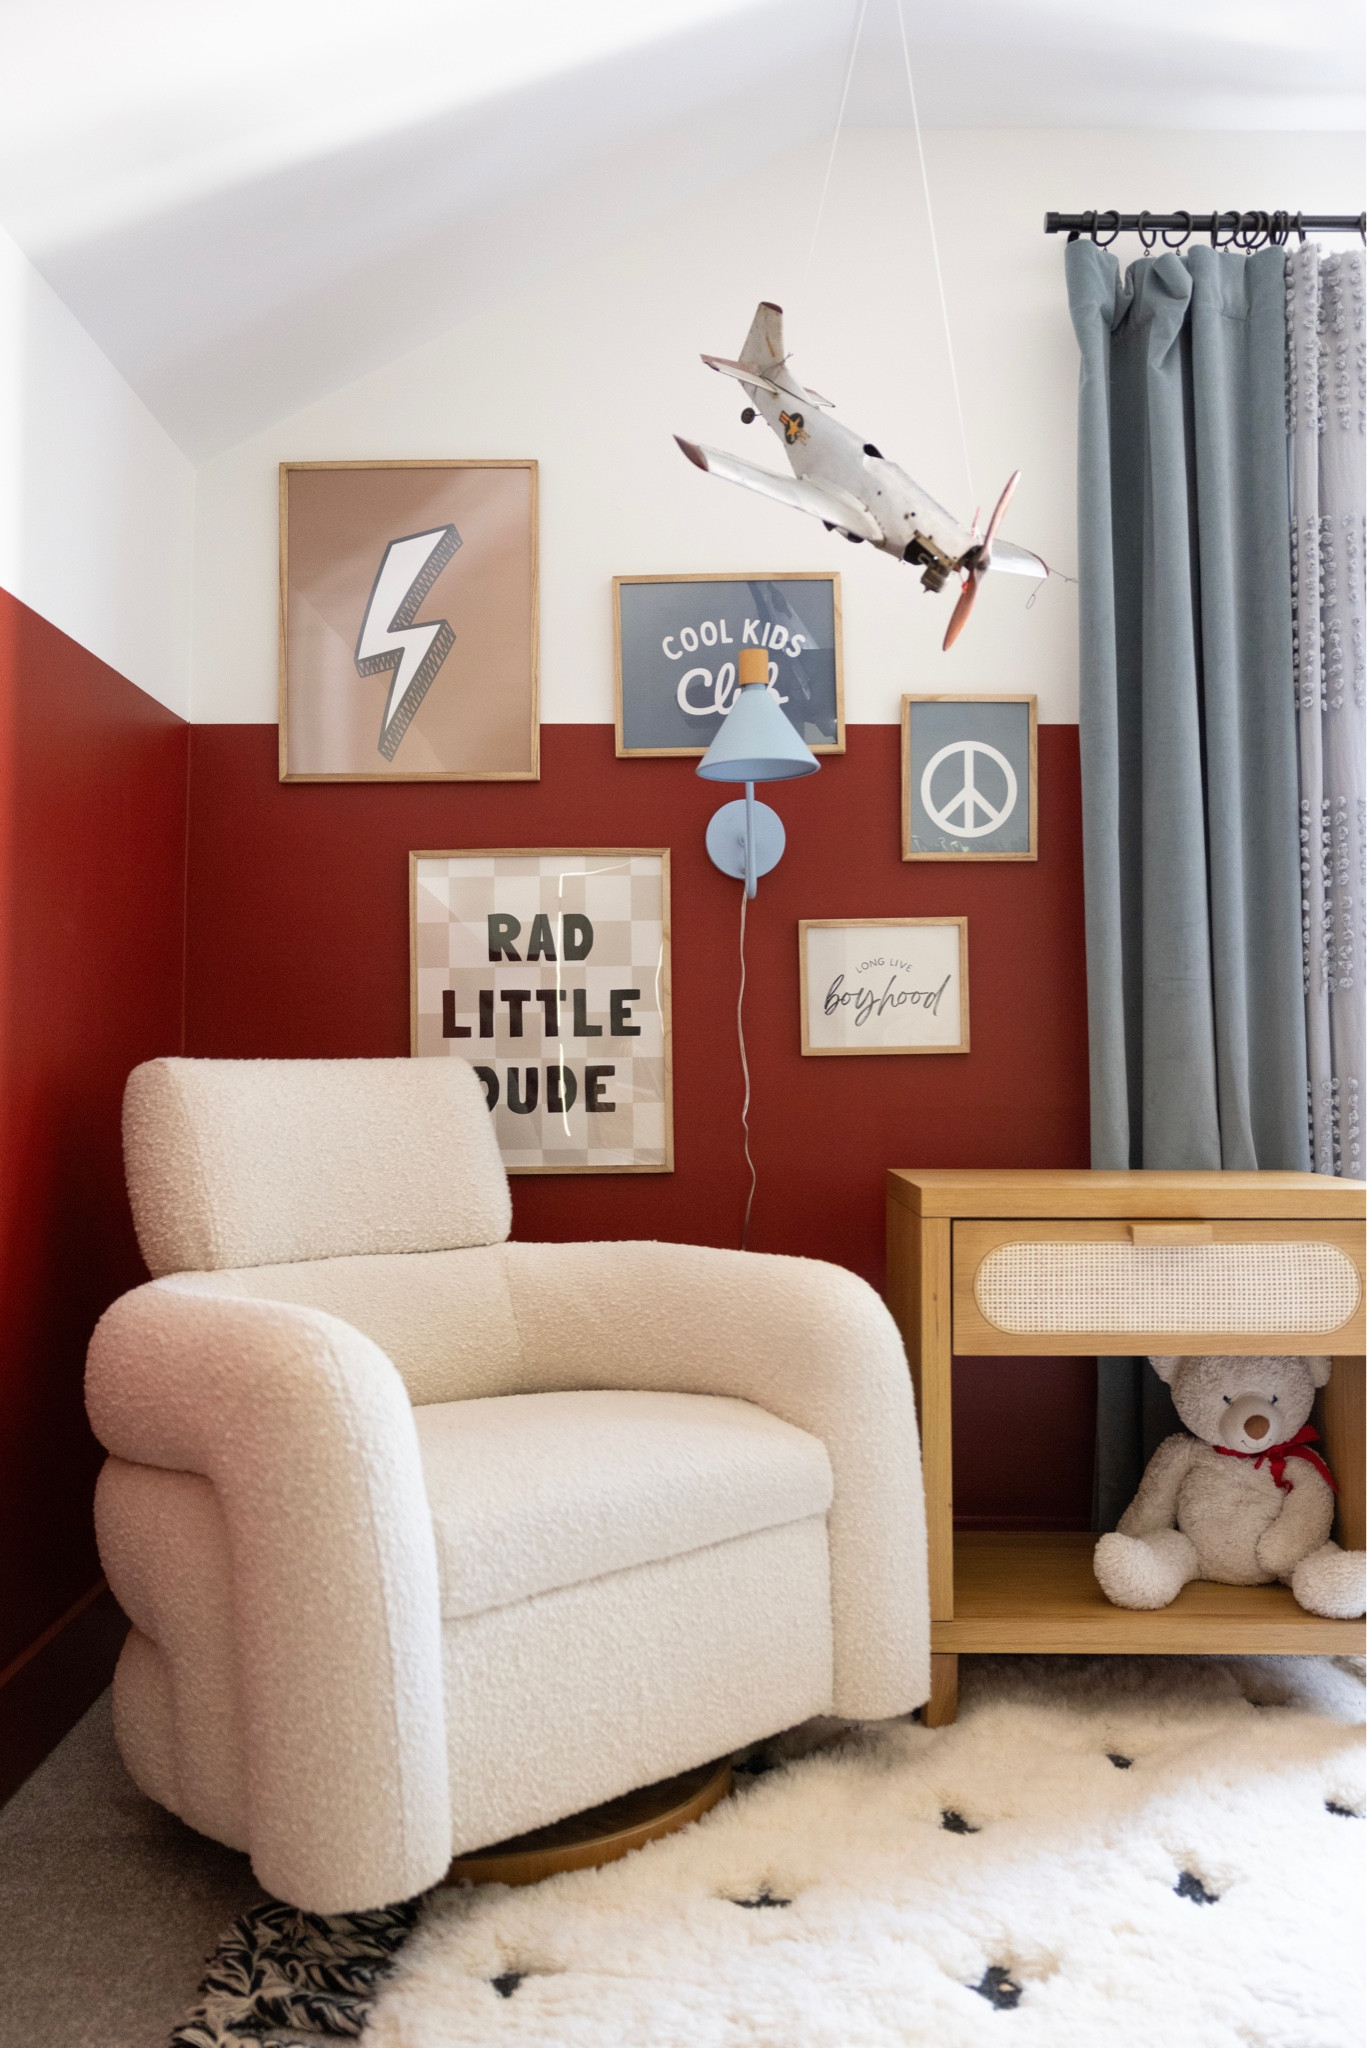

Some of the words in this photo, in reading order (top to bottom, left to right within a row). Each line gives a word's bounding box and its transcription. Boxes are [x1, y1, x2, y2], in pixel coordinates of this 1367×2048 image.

[662, 618, 733, 660] COOL
[742, 618, 806, 658] KIDS
[676, 661, 789, 715] Clb
[488, 912, 594, 962] RAD
[855, 957, 885, 974] LONG
[889, 958, 913, 973] LIVE
[442, 988, 641, 1039] LITTLE
[824, 973, 951, 1027] boyhood
